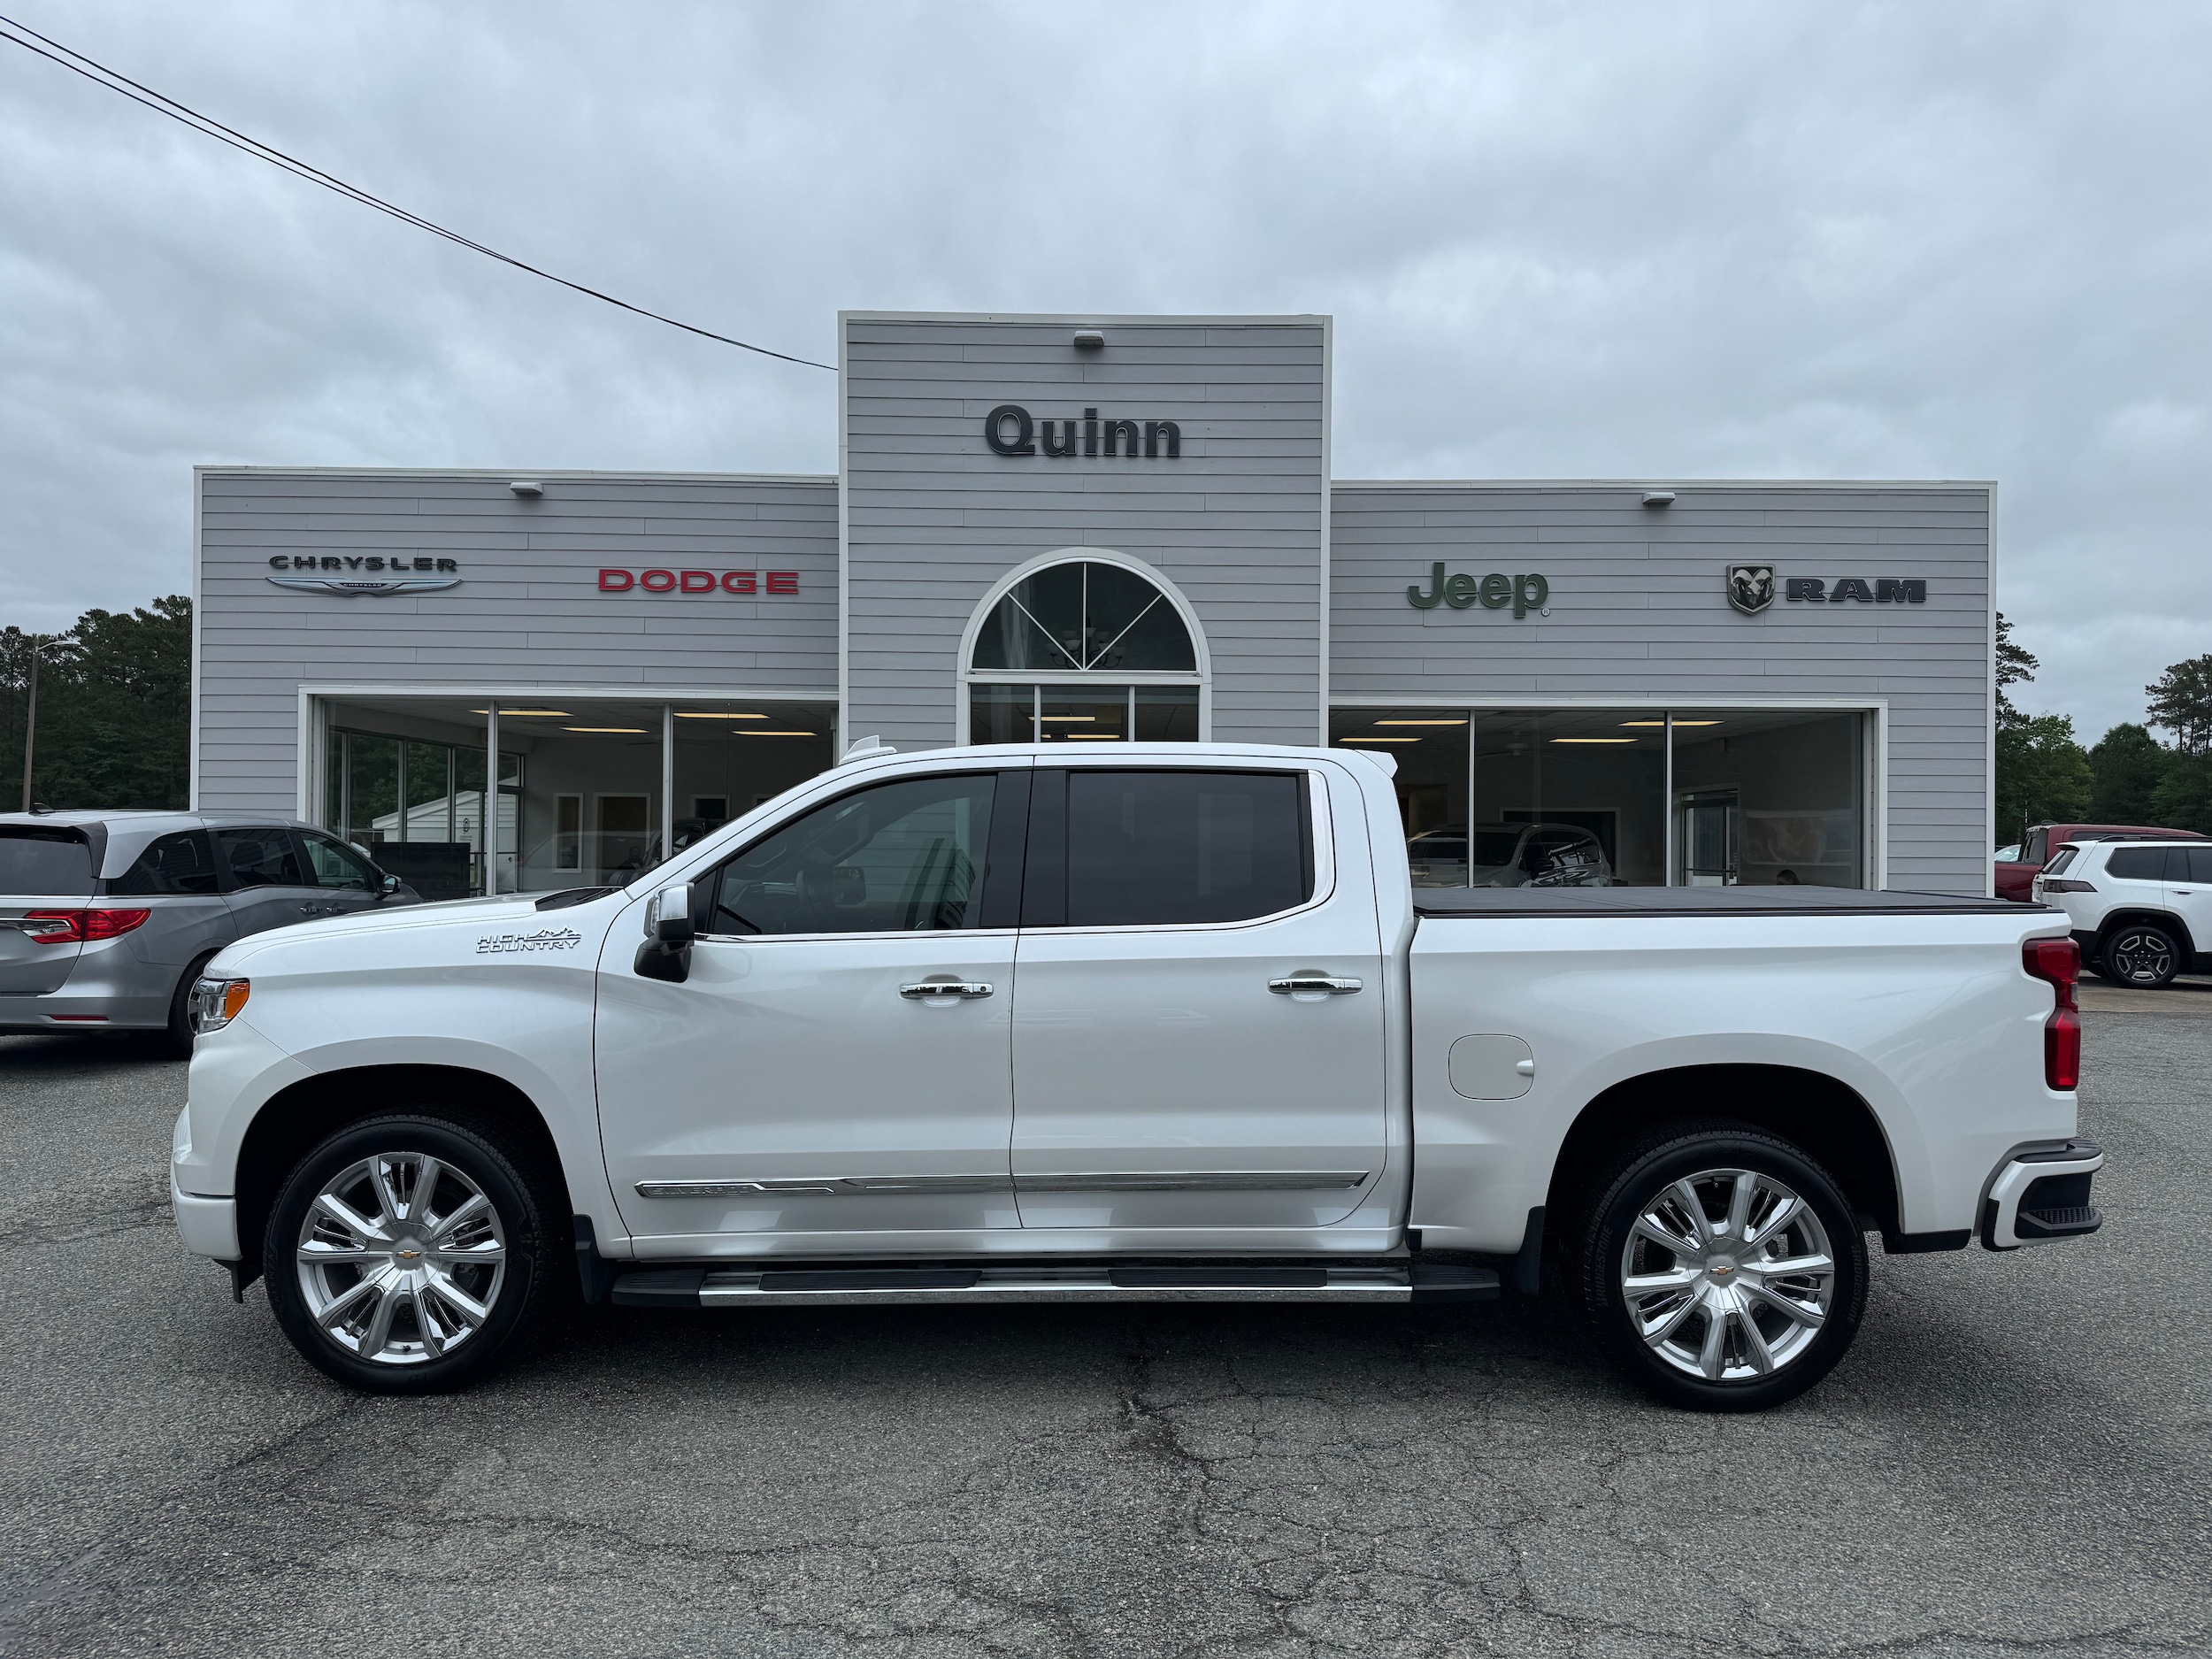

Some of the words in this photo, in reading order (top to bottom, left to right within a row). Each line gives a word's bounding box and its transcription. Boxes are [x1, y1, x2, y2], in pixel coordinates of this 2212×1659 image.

[985, 404, 1181, 457] Quinn
[269, 556, 457, 572] CHRYSLER
[598, 569, 800, 595] DODGE
[1408, 562, 1549, 618] Jeep
[1786, 578, 1927, 602] RAM
[476, 940, 580, 953] COUNTRY
[477, 933, 530, 944] HIGH
